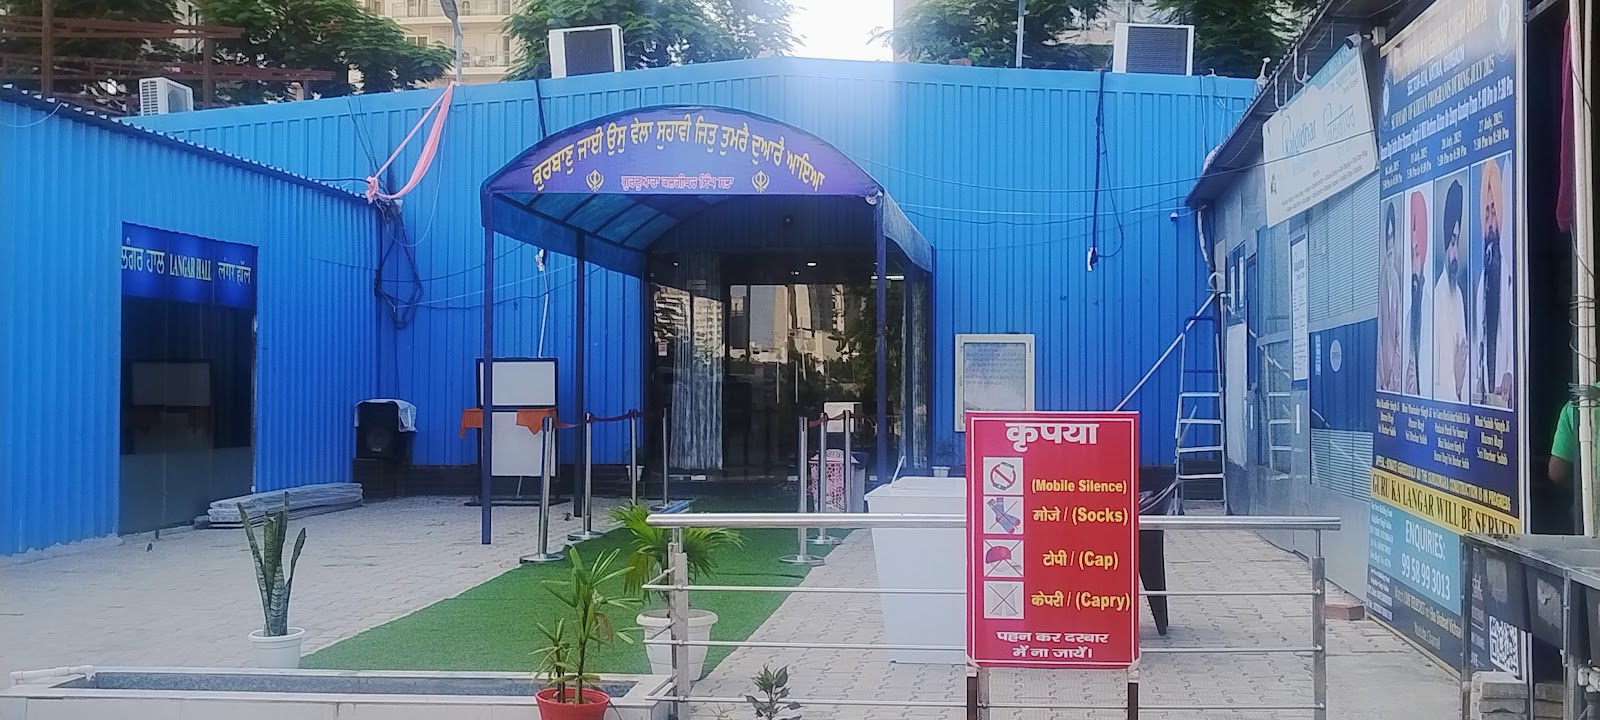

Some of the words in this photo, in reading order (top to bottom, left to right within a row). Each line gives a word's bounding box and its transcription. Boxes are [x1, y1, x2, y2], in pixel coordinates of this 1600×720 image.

[630, 117, 654, 145] ਵੇਲਾ
[694, 115, 718, 153] ਜਿਤੁ
[146, 250, 165, 275] ਹਾਲ
[169, 253, 196, 279] LANGAR
[196, 258, 212, 281] HALL
[1005, 422, 1100, 452] कृपया
[1031, 478, 1075, 494] (Mobile
[1078, 479, 1127, 495] Silence)
[1032, 505, 1061, 522] मोजे
[1063, 506, 1068, 522] /
[1072, 506, 1129, 526] (Socks)
[1372, 473, 1390, 498] GURU
[1391, 479, 1401, 502] KA
[1402, 484, 1434, 519] LANGAR
[1436, 496, 1459, 527] WILL
[1461, 506, 1473, 533] BE
[1405, 519, 1446, 561] ENQUIRIES:
[1042, 549, 1067, 567] टोपी
[1070, 551, 1075, 566] /
[1079, 550, 1119, 571] (Cap)
[1401, 552, 1410, 578] 99
[1411, 558, 1420, 584] 58
[1421, 563, 1431, 590] 99
[1431, 569, 1451, 601] 3013
[1031, 590, 1064, 608] केपरी
[1067, 591, 1072, 607] /
[1075, 591, 1131, 611] (Capry)
[996, 631, 1033, 643] पहन
[1035, 632, 1062, 643] कर
[1012, 644, 1030, 658] में
[1030, 648, 1050, 658] ना
